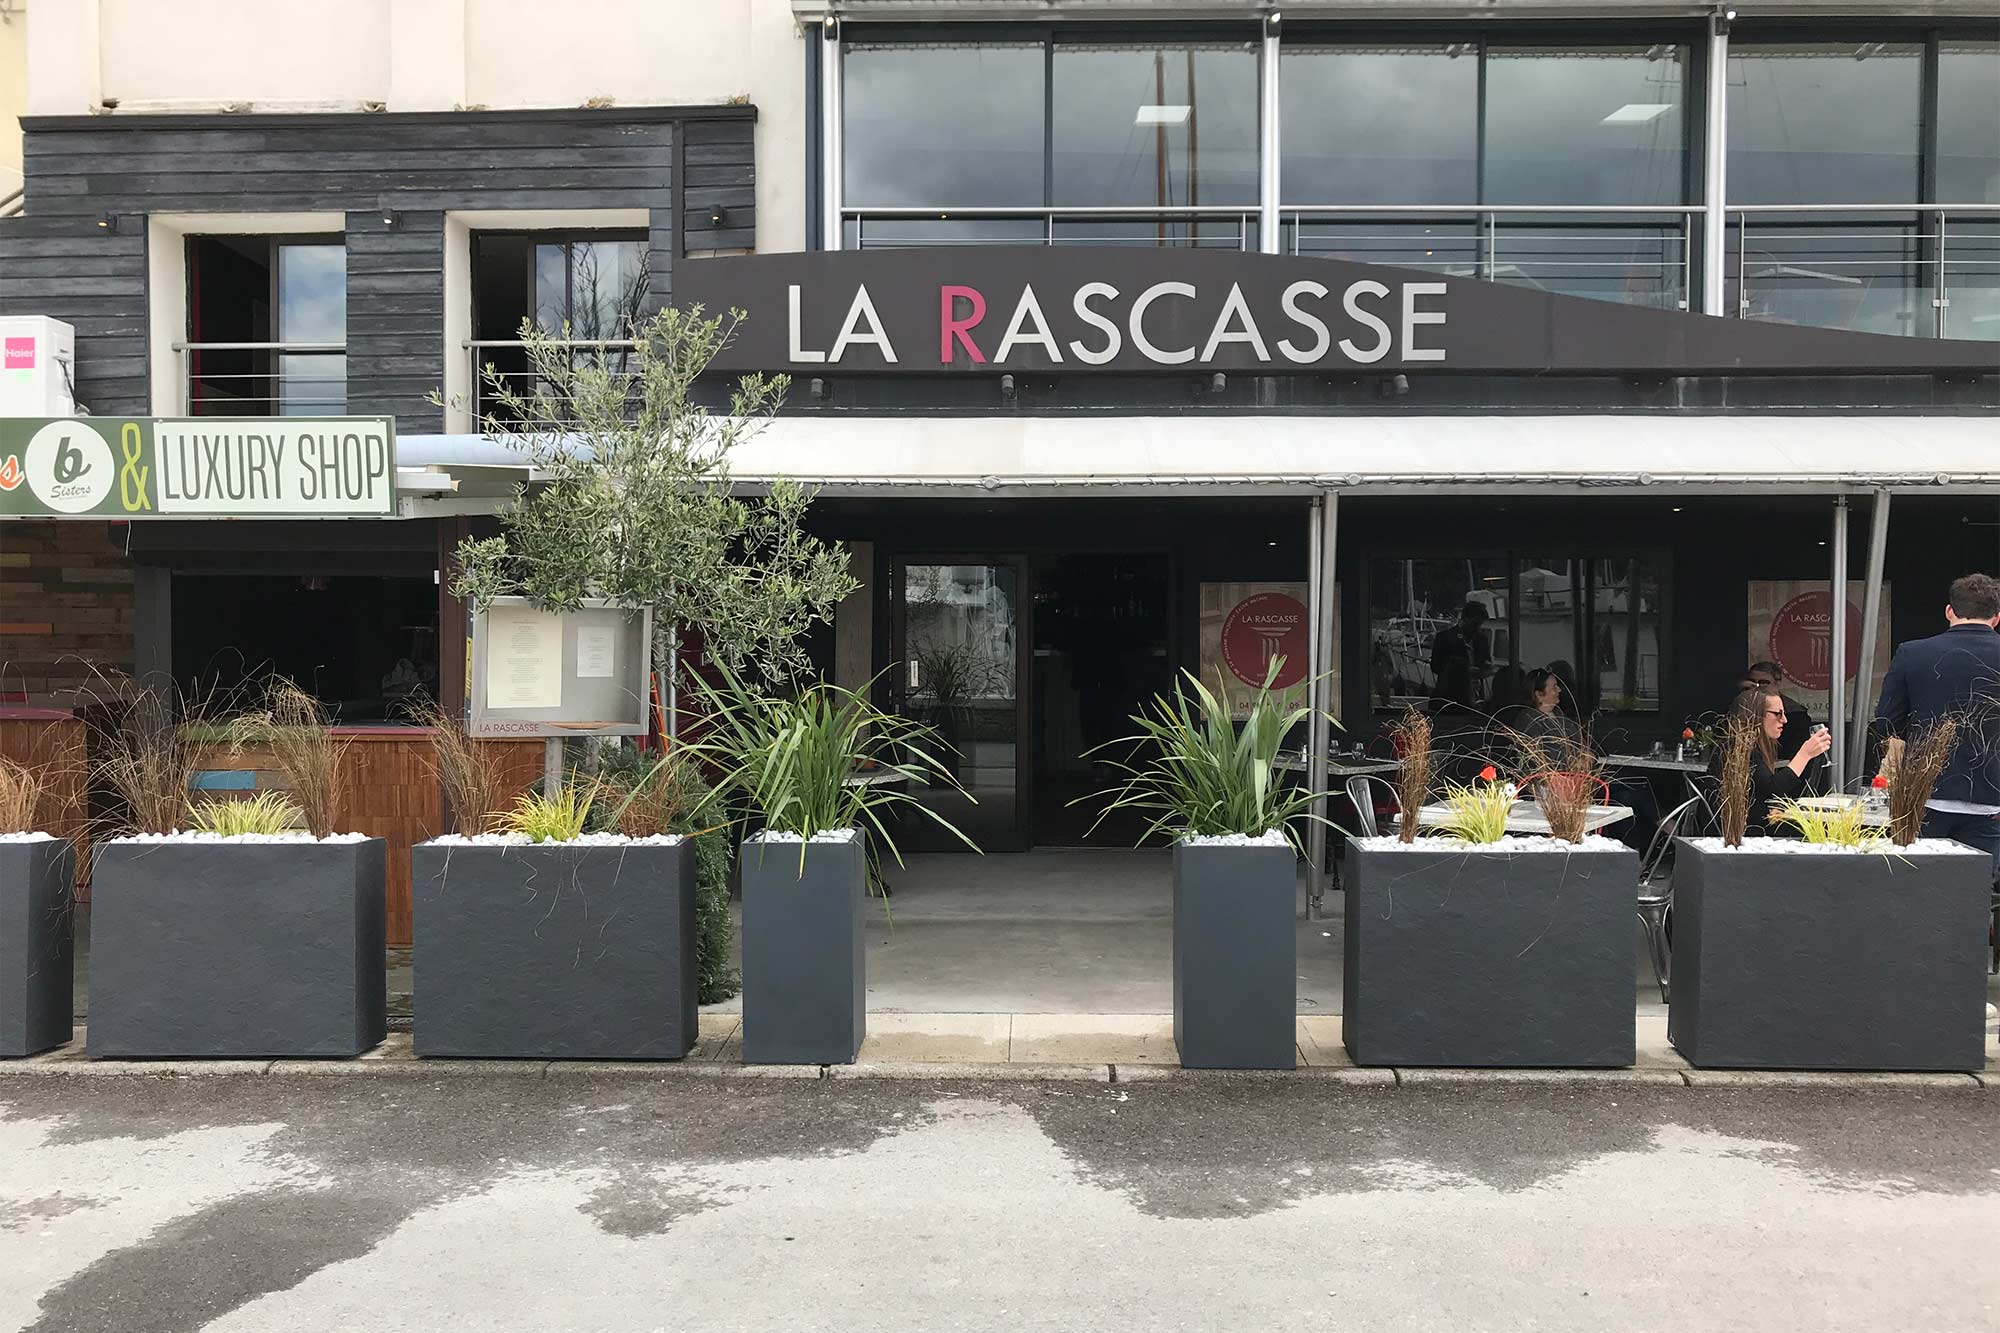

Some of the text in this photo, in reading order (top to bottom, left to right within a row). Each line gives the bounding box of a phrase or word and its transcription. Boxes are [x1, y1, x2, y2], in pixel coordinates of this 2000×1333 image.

[788, 280, 1447, 364] LA RASCASSE
[6, 348, 34, 358] Haier
[54, 436, 92, 484] b
[121, 423, 384, 512] & LUXURY SHOP
[50, 485, 92, 499] Sisters
[1242, 614, 1299, 623] LA RASCASSE
[1791, 614, 1830, 622] LA RASC
[479, 723, 540, 732] LA RASCASSE
